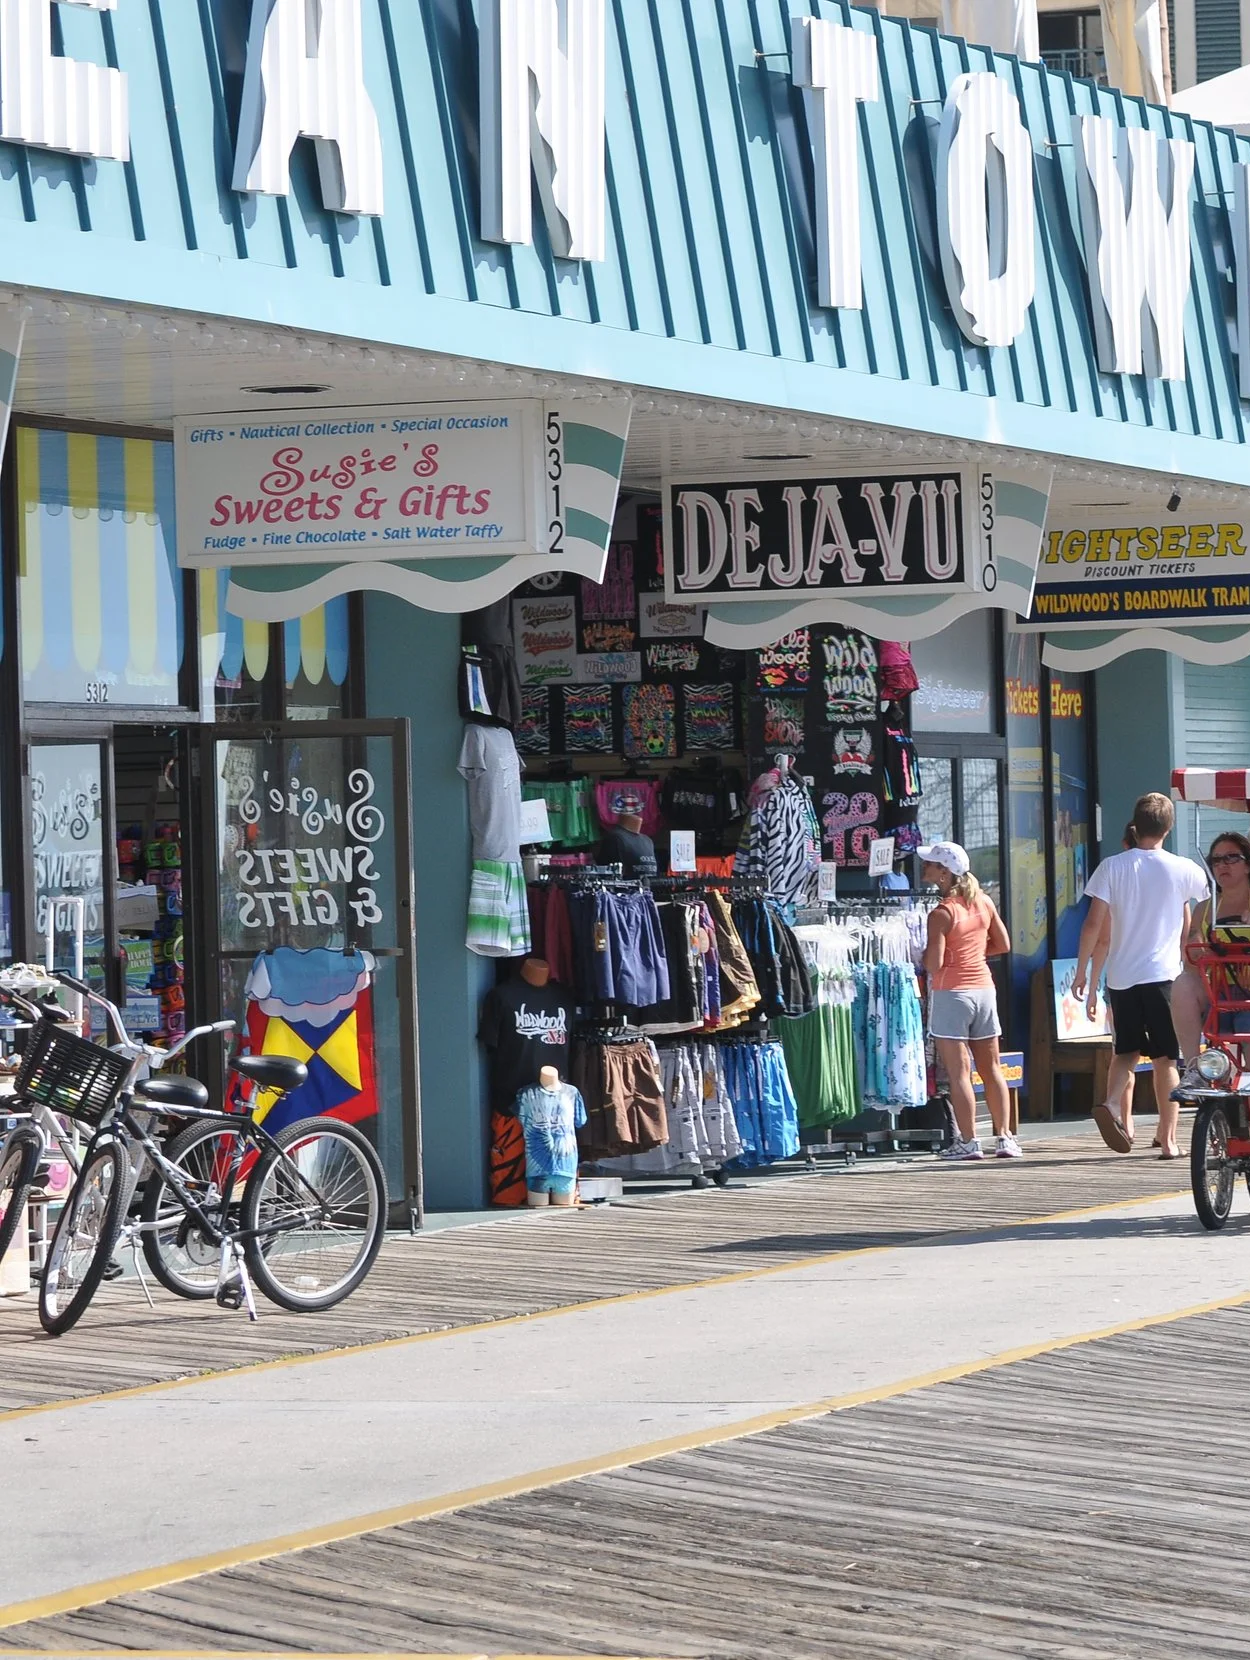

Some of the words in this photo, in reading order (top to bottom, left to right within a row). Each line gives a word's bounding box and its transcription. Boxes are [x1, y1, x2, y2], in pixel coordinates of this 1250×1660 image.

[190, 427, 224, 443] Gifts
[240, 424, 301, 441] Nautical
[304, 420, 375, 438] Collection
[390, 416, 442, 435] Special
[446, 414, 509, 431] Occasion
[546, 412, 564, 554] 5312
[210, 491, 342, 528] Sweets
[354, 486, 387, 520] &
[399, 483, 492, 521] Gifts
[203, 534, 247, 552] Fudge
[262, 531, 292, 546] Fine
[295, 527, 367, 544] Chocolate
[382, 525, 412, 541] Salt
[415, 523, 462, 540] Water
[464, 521, 504, 540] Taffy
[676, 479, 960, 590] DEJA-VU
[980, 472, 997, 592] 5310
[1039, 523, 1247, 565] IGHTSEER
[1084, 563, 1144, 578] DISCOUNT
[1149, 562, 1196, 575] TICKETS
[1035, 592, 1120, 615] WILDWOOD'S
[1124, 588, 1208, 611] BOARDWALK
[1211, 586, 1250, 607] TRAM
[86, 683, 109, 702] 5312
[1051, 680, 1083, 717] Here
